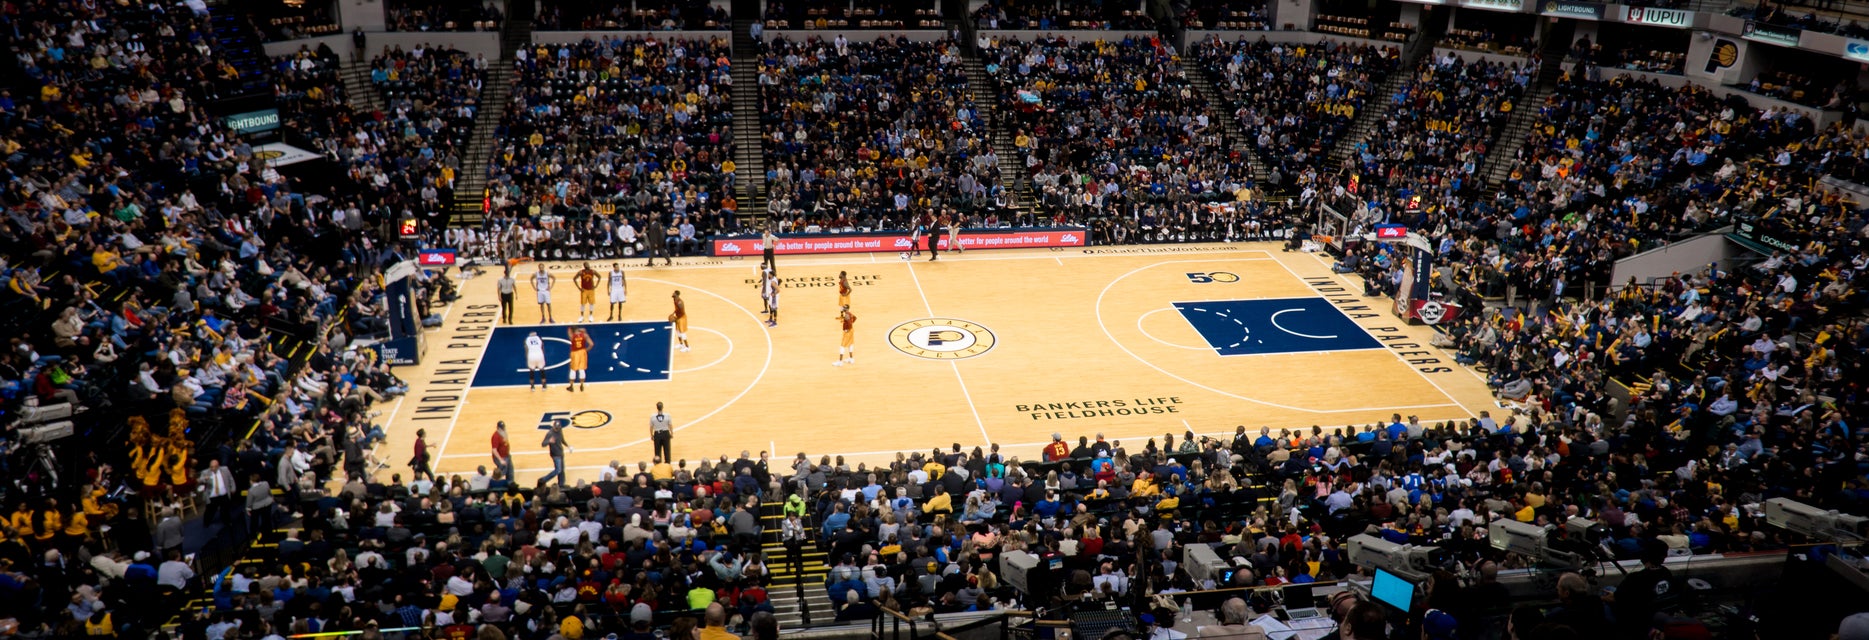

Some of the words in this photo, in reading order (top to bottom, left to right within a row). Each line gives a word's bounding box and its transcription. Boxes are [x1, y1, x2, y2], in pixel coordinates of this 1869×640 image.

[1557, 4, 1595, 14] LIGHTBOUND
[1646, 9, 1686, 25] IUPUI
[227, 113, 279, 130] IGHTBOUND
[786, 242, 803, 250] better
[804, 241, 812, 250] for
[814, 241, 833, 251] people
[834, 240, 853, 249] around
[854, 239, 864, 248] the
[865, 238, 881, 248] world
[959, 236, 975, 245] better
[976, 237, 984, 245] for
[985, 237, 1003, 247] people
[1004, 236, 1022, 245] around
[1024, 235, 1032, 243] the
[1033, 235, 1049, 243] world
[1760, 233, 1793, 251] LOCKHAR
[1303, 275, 1381, 320] INDIANA
[446, 303, 499, 349] PACERS
[1366, 326, 1454, 374] PACERS
[411, 358, 476, 421] INDIANA
[1015, 399, 1127, 412] BANKERS
[1135, 396, 1183, 406] LIFE
[1031, 405, 1180, 421] FIELDHOUSE
[1055, 447, 1066, 457] 13
